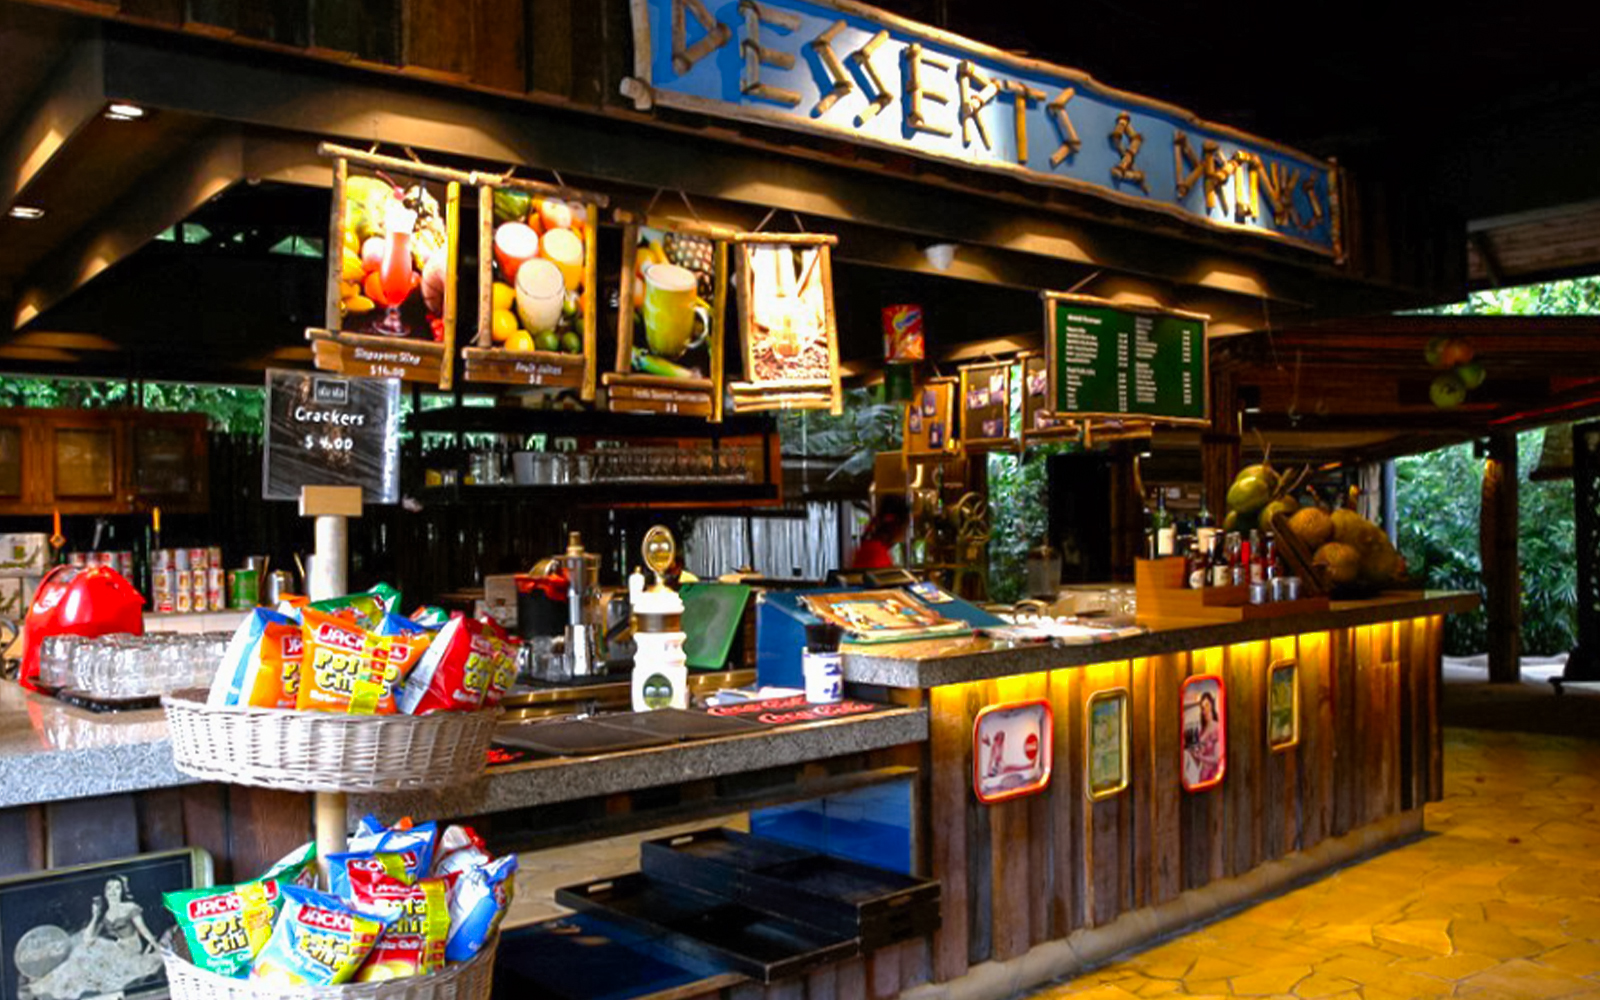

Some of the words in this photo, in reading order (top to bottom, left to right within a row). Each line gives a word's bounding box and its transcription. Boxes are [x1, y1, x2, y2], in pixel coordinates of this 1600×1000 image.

[671, 0, 1082, 168] DESSERTS
[1173, 129, 1324, 231] DRINKS
[294, 406, 365, 426] Crackers
